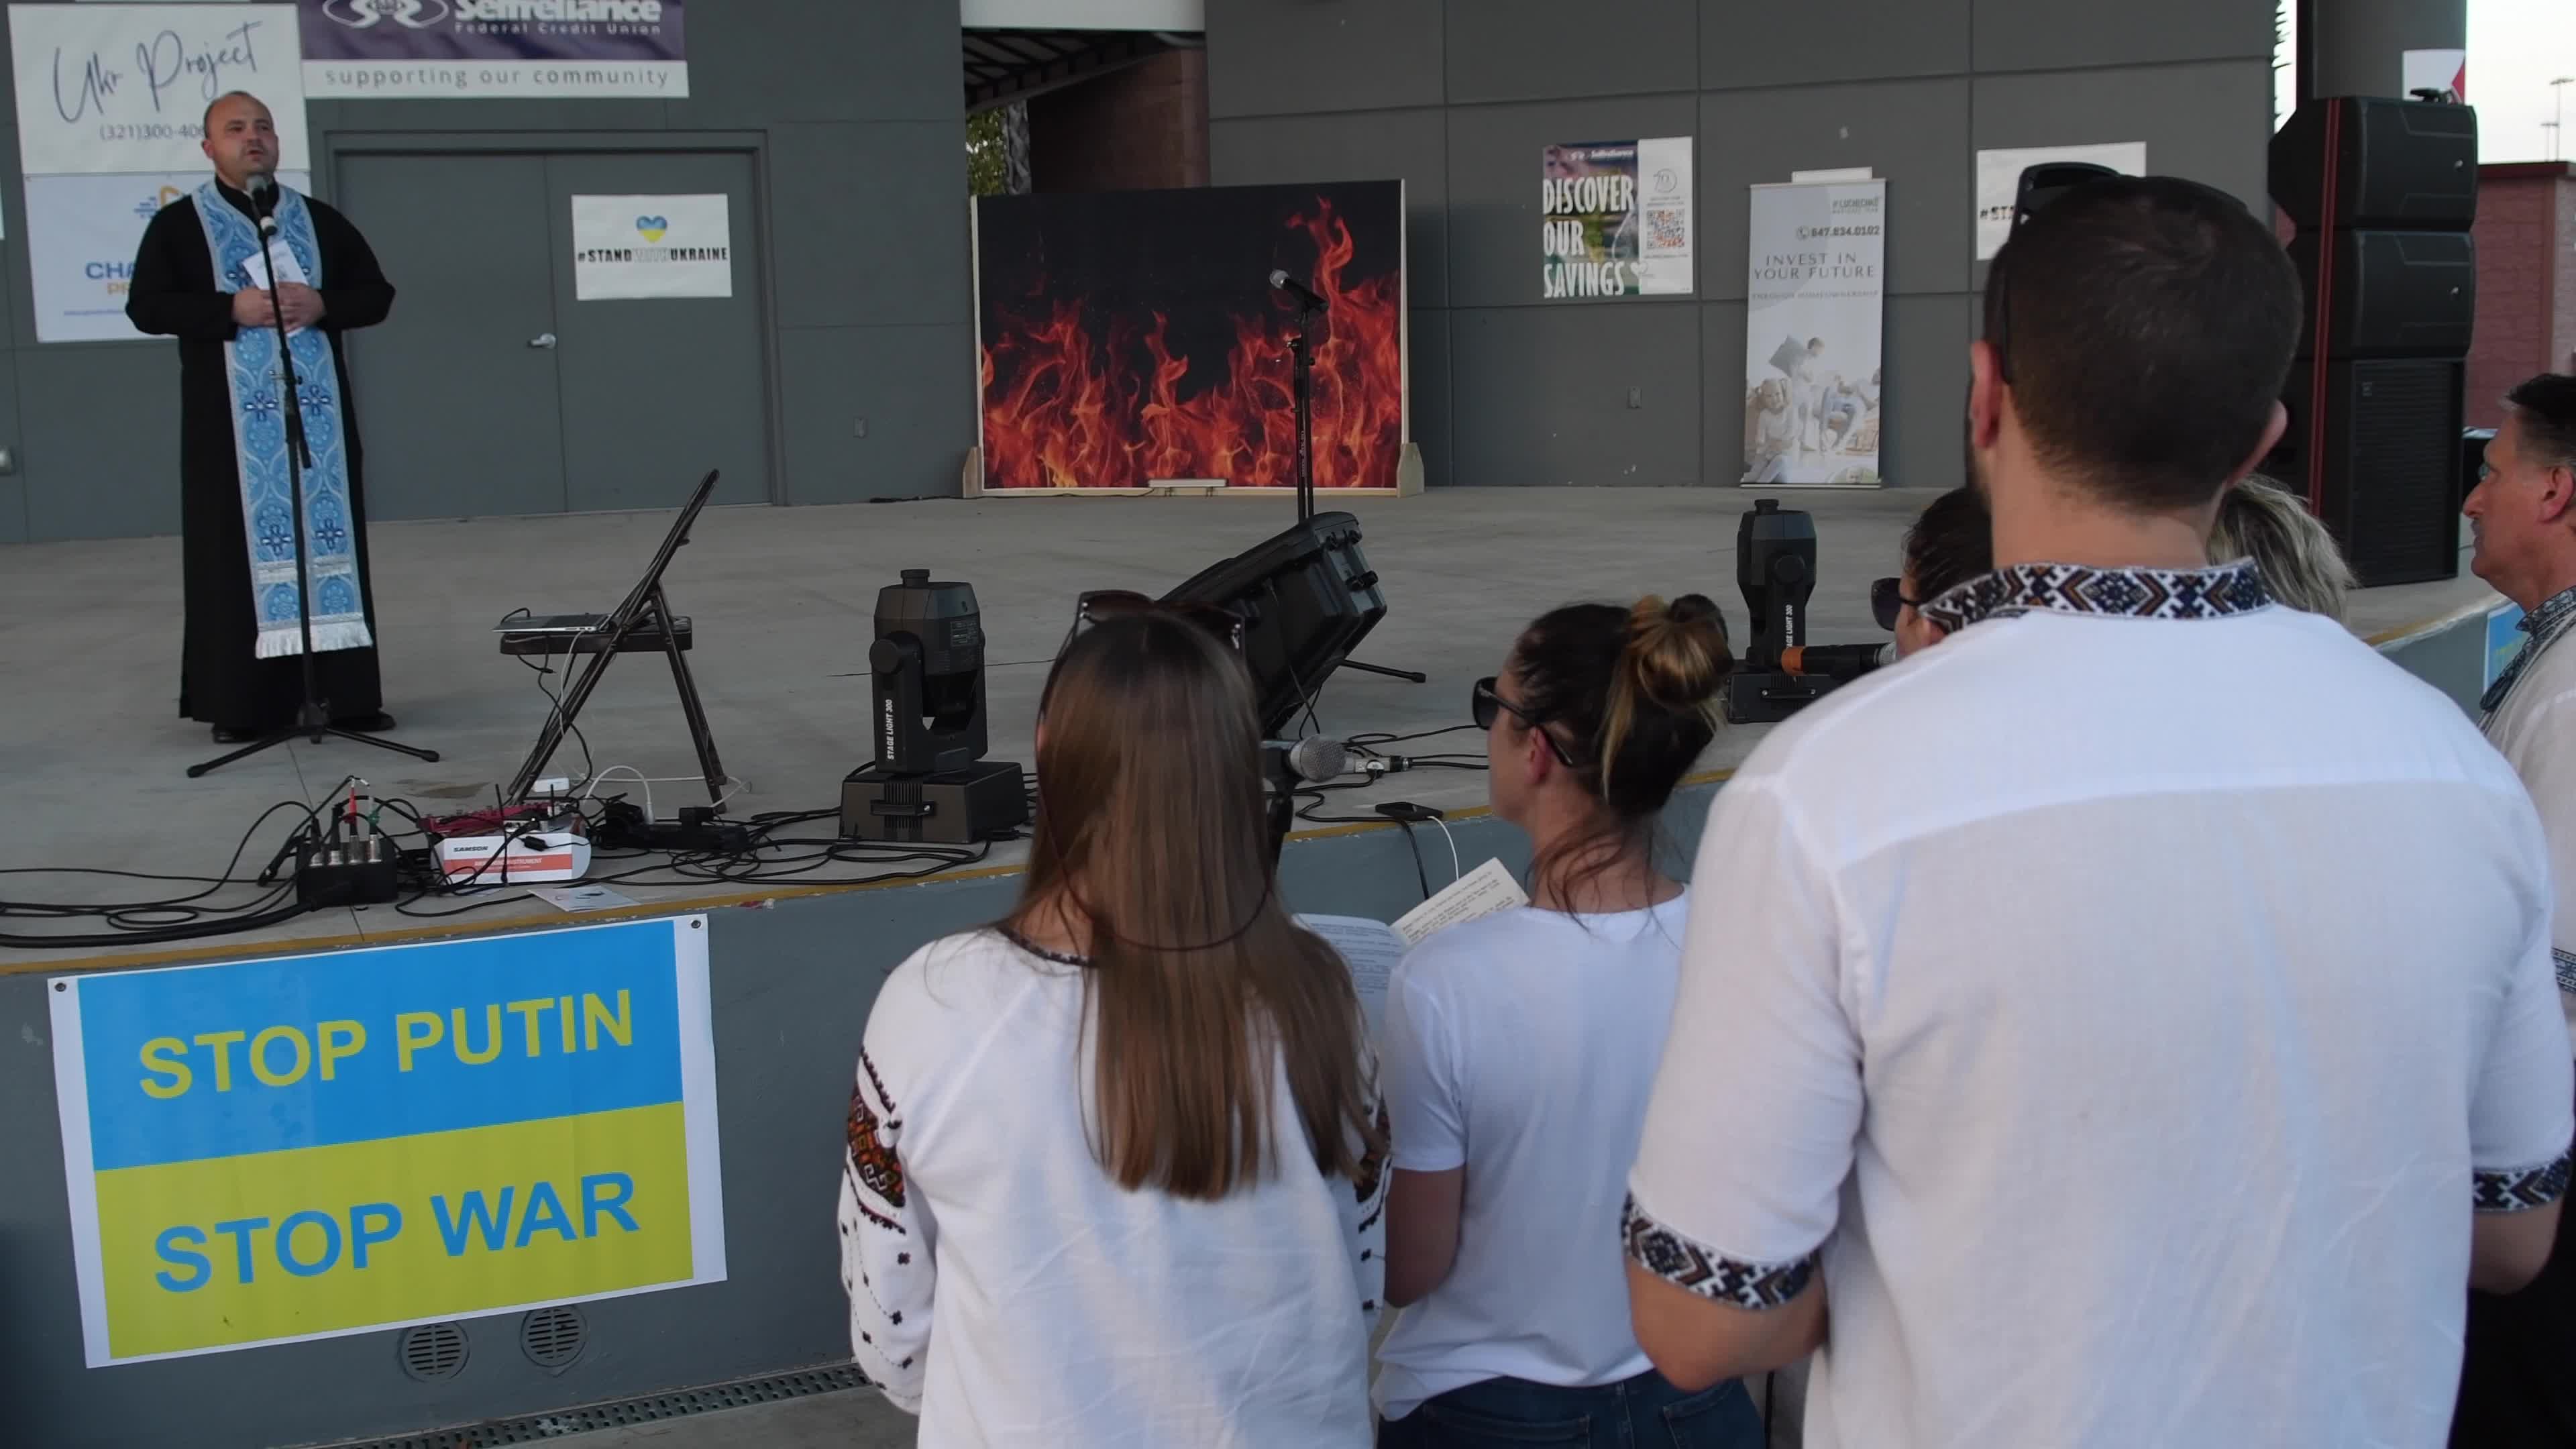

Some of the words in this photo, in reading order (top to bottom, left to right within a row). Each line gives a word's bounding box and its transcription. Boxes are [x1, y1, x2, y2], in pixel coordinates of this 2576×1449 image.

[455, 22, 528, 34] Federal
[537, 22, 596, 34] Credit
[606, 23, 661, 35] Union
[136, 21, 263, 111] Project
[325, 68, 468, 90] supporting
[479, 69, 520, 85] our
[533, 68, 668, 89] community
[1543, 174, 1635, 214] DISCOVER
[1544, 221, 1586, 257] OUR
[1766, 252, 1828, 266] INVEST
[1837, 252, 1857, 264] IN
[1544, 261, 1625, 298] SAVINGS
[1754, 266, 1799, 280] YOUR
[1809, 265, 1874, 279] FUTURE
[885, 699, 893, 712] 300
[885, 713, 894, 735] LIGHT
[886, 736, 895, 760] STAGE
[139, 1019, 367, 1099] STOP
[395, 989, 633, 1073] PUTIN
[154, 1201, 404, 1293] STOP
[429, 1171, 641, 1258] WAR
